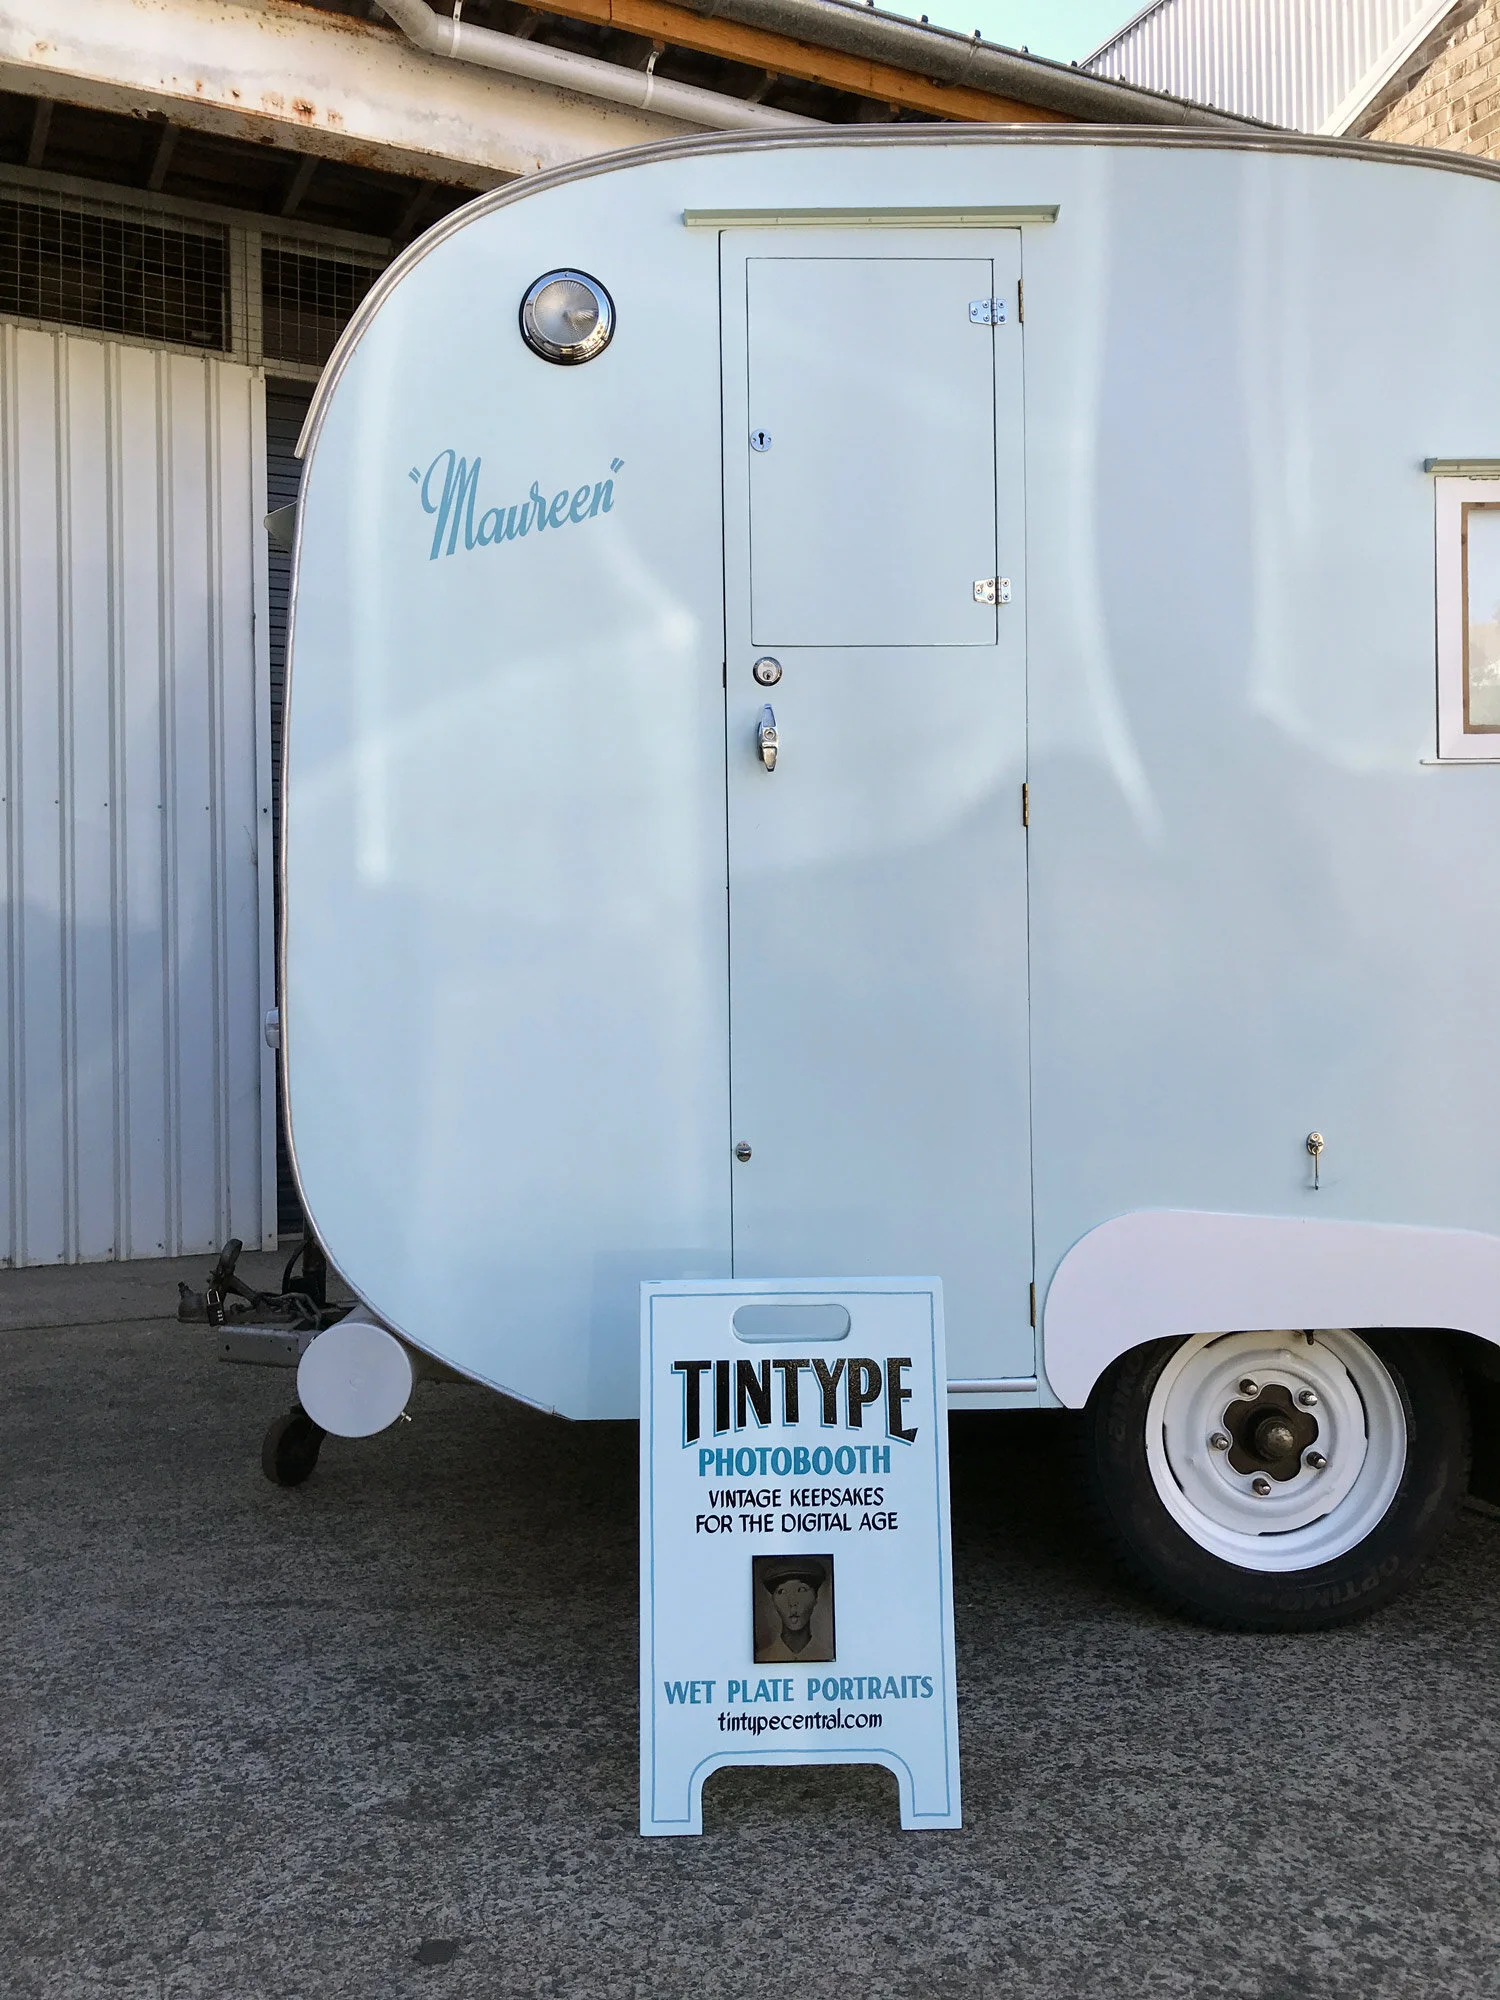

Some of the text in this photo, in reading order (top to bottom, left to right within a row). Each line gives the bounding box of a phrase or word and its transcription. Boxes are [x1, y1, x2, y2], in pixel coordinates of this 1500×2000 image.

[671, 1357, 919, 1449] TINTYPE
[698, 1445, 891, 1477] PHOTOBOOTH
[708, 1486, 885, 1509] VINTAGE KEEPSAKES
[695, 1511, 899, 1534] FOR THE DIGITAL AGE
[663, 1675, 934, 1705] WET PLATE PORTRAITS
[717, 1707, 883, 1737] tintypecentral.com
